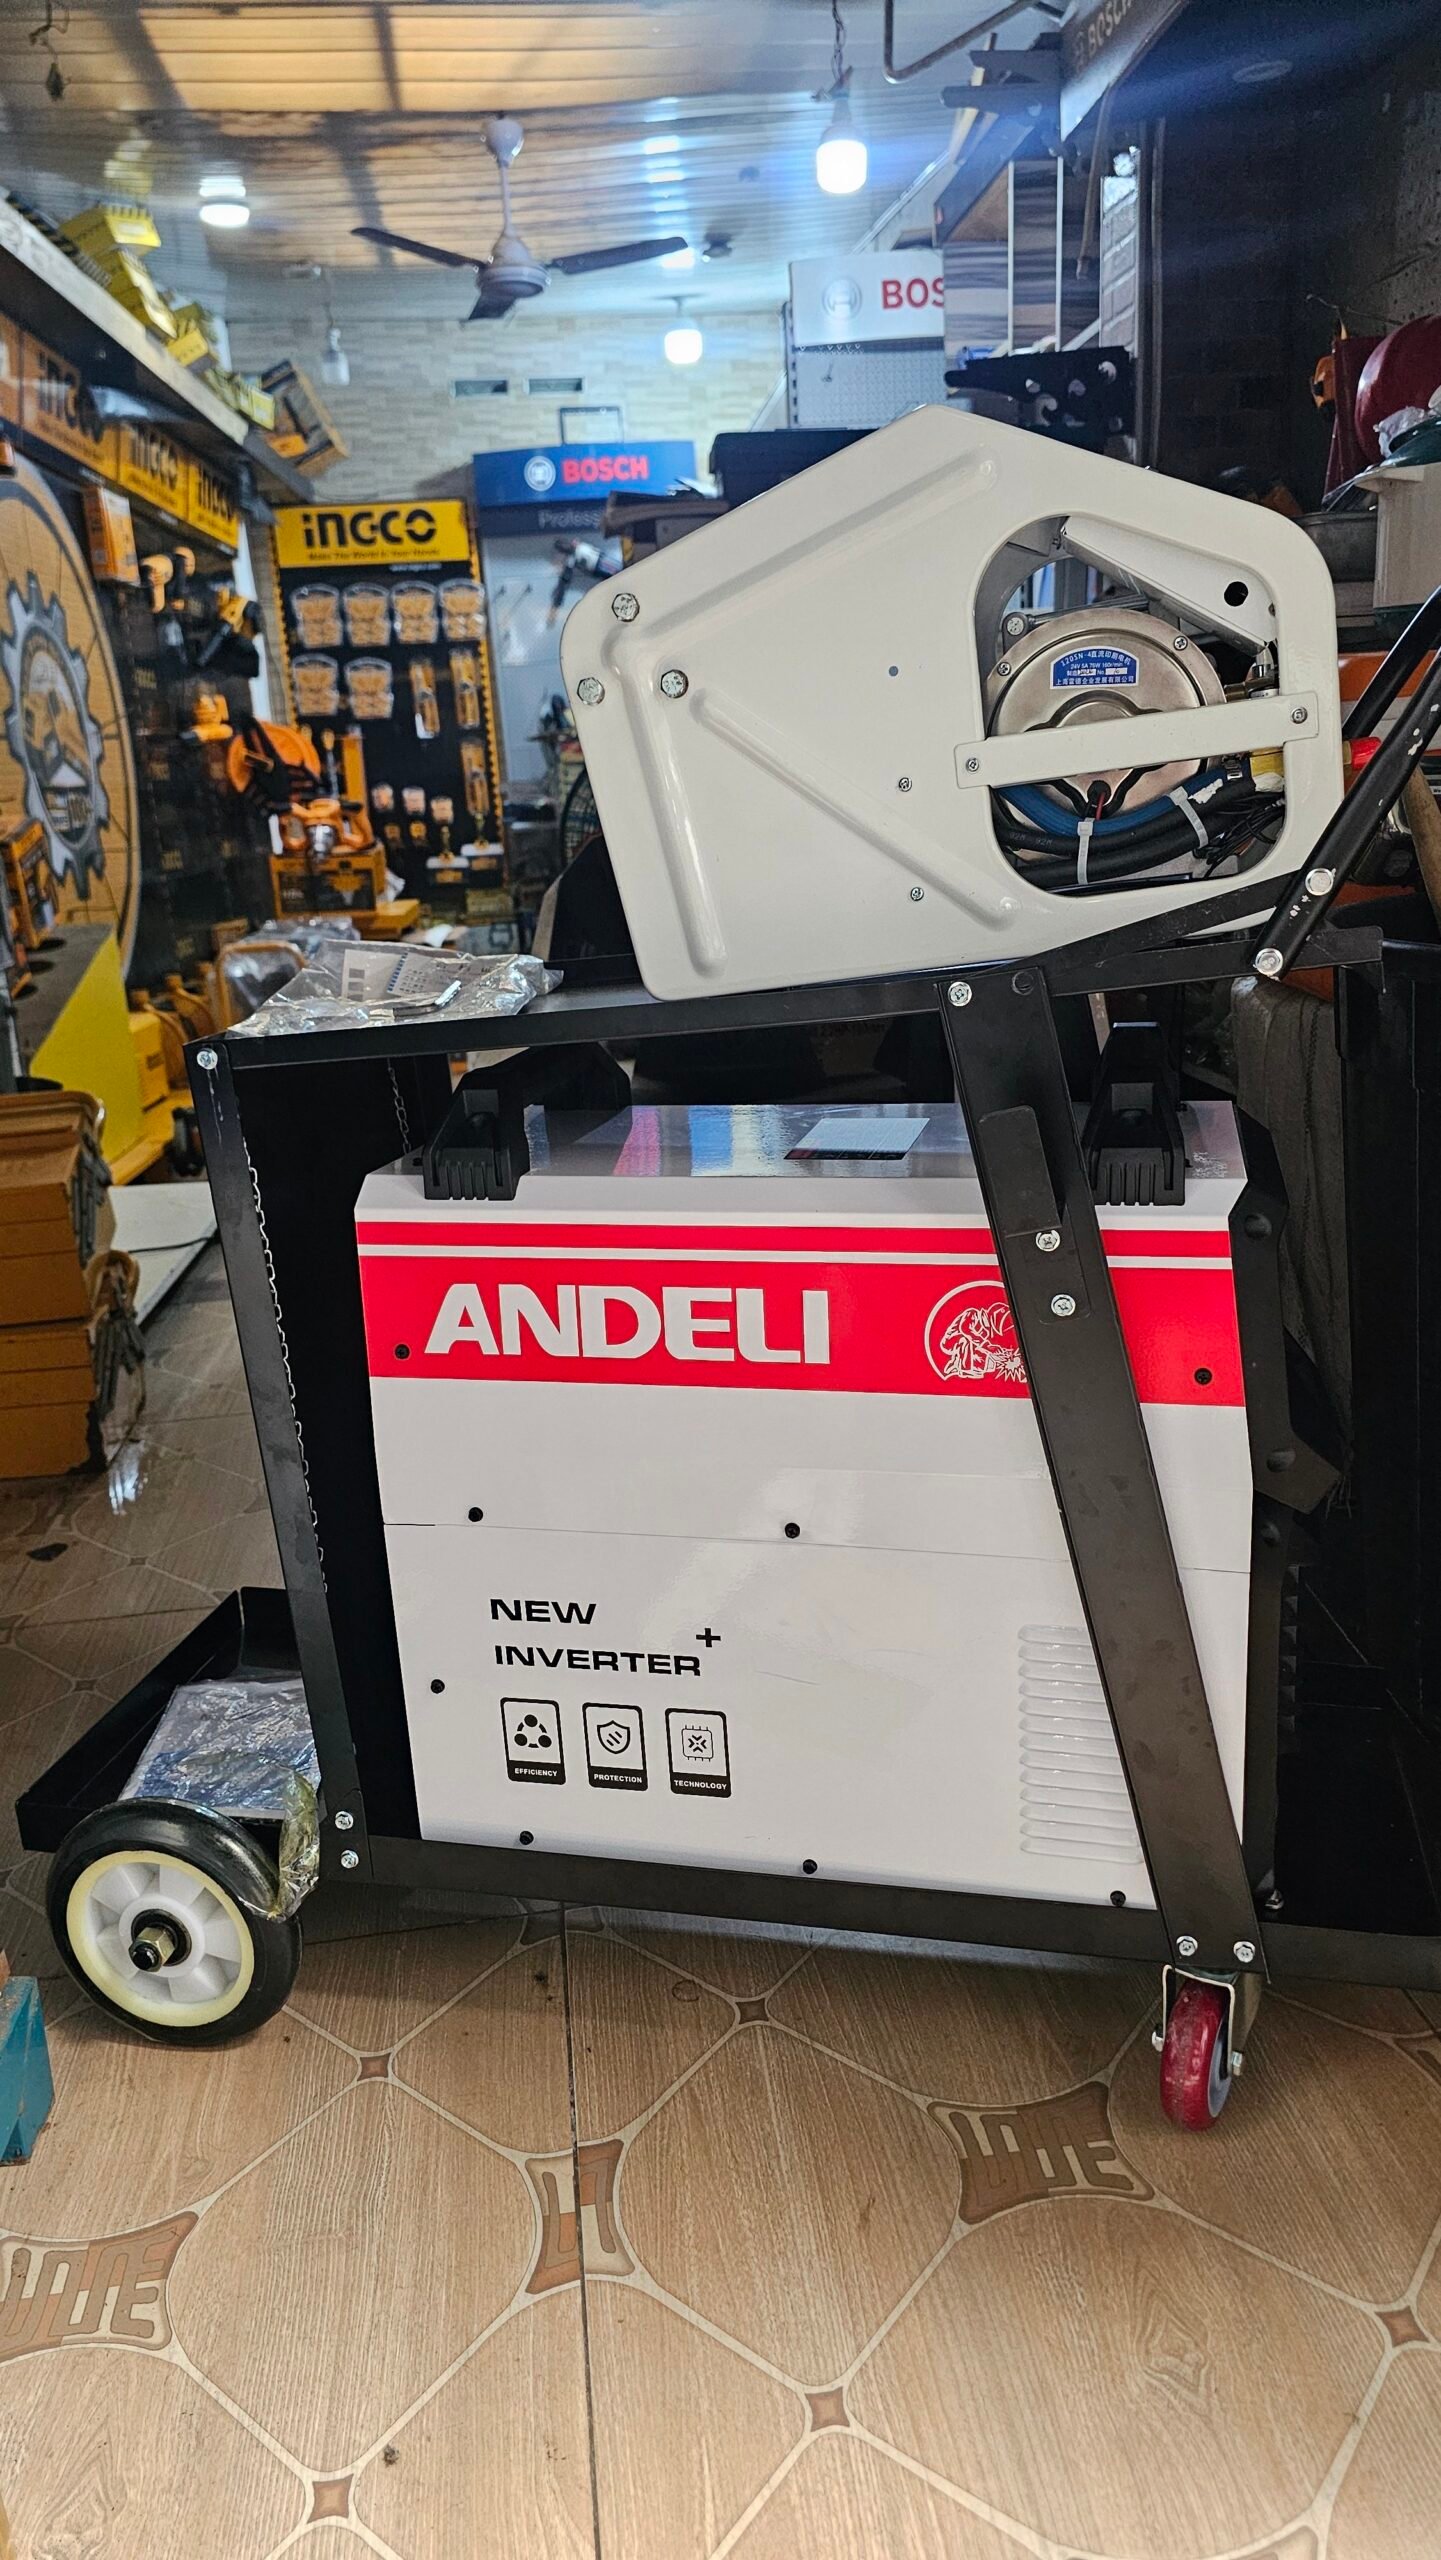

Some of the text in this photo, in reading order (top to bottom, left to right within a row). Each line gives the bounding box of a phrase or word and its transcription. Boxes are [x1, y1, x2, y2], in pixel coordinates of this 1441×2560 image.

[562, 456, 648, 485] BOSCH
[424, 1283, 830, 1365] ANDELI
[490, 1598, 596, 1625] NEW
[495, 1645, 701, 1677] INVERTER
[514, 1767, 558, 1777] EFFICIENCY
[593, 1773, 643, 1784] PROTECTION
[673, 1779, 728, 1790] TECHNOLOGY
